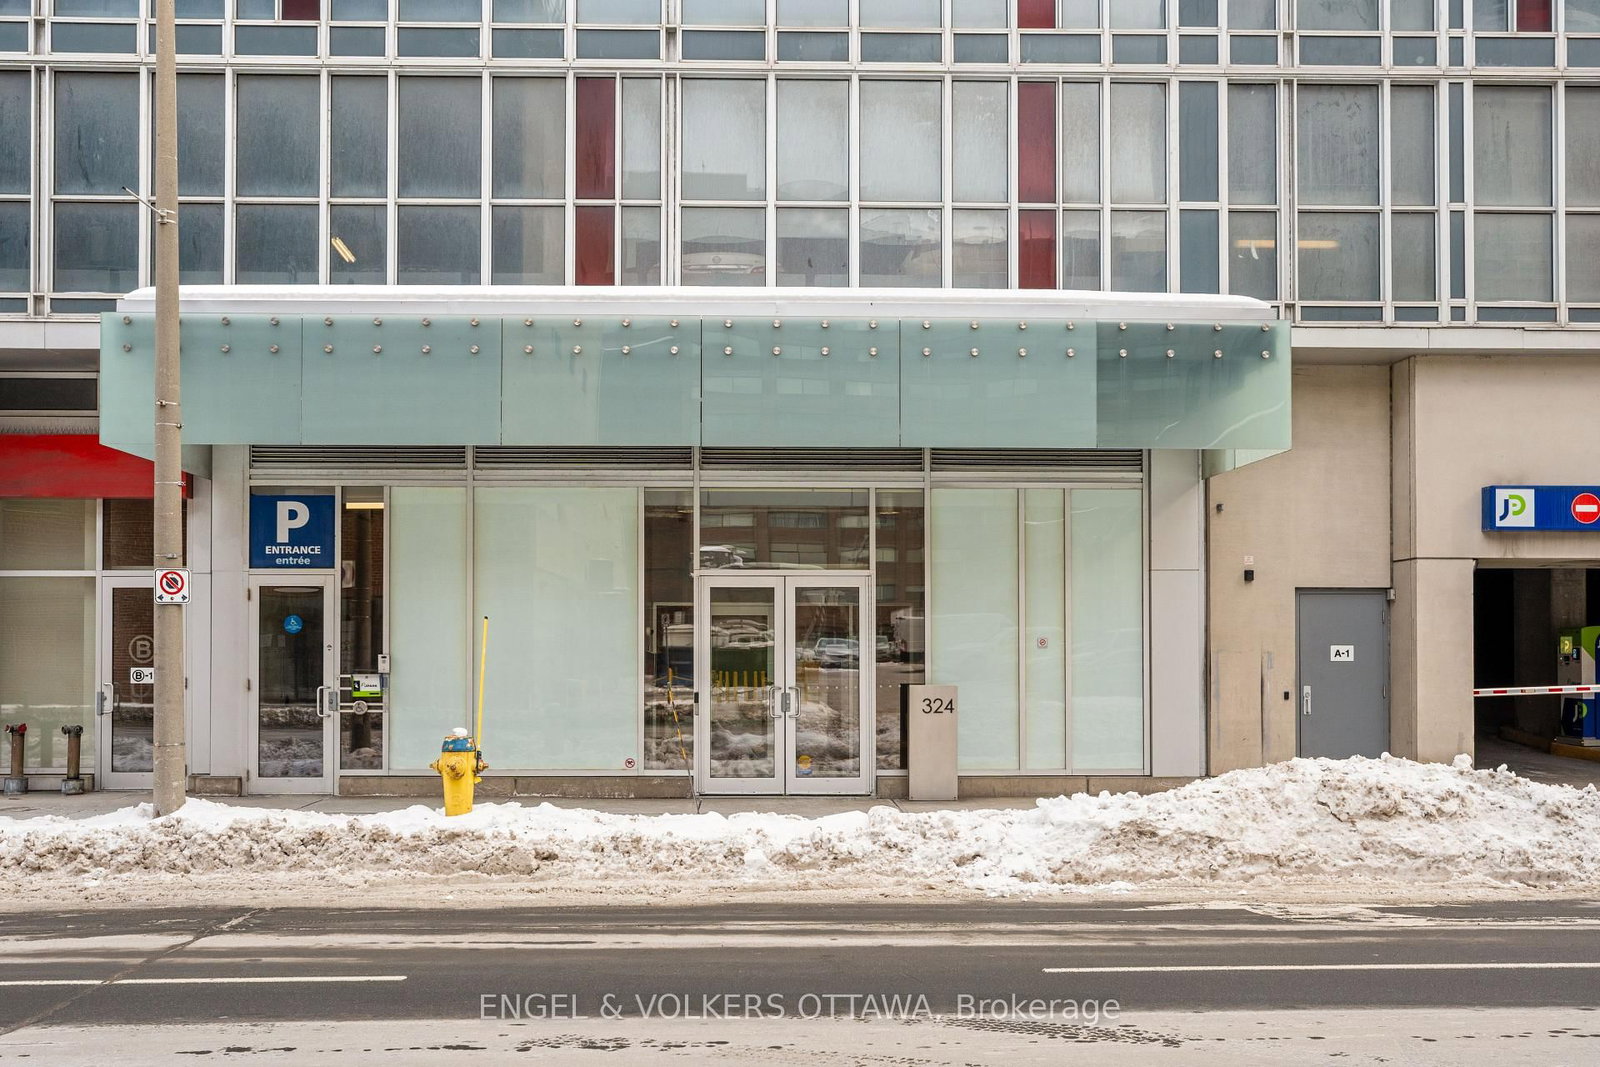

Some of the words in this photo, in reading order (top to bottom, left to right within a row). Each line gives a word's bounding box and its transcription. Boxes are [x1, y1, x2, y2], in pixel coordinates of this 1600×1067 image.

[276, 501, 310, 543] P
[265, 546, 321, 554] ENTRANCE
[275, 556, 311, 565] entrée
[1334, 649, 1350, 658] A-1
[133, 670, 153, 681] B-1
[922, 698, 955, 714] 324
